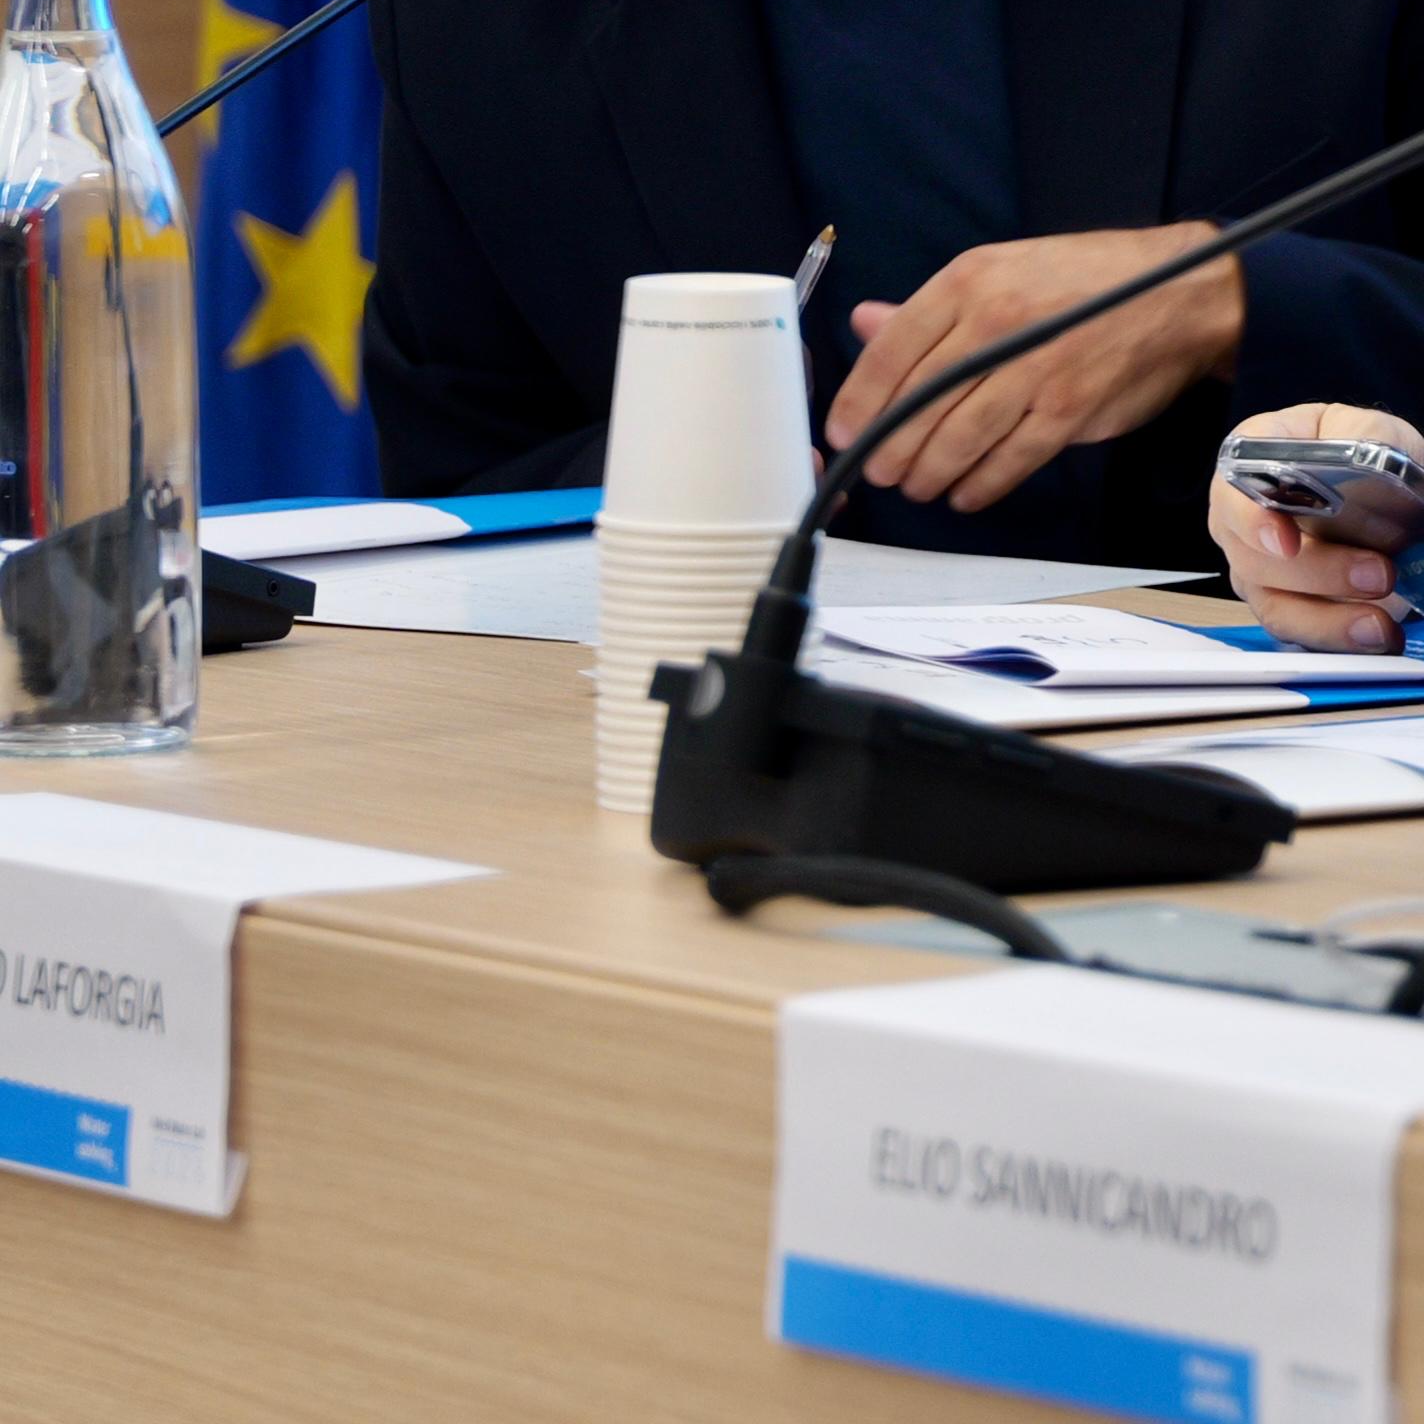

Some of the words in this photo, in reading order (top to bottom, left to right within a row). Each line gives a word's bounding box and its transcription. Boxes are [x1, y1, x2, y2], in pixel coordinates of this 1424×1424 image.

[13, 954, 167, 1035] LAFORGIA
[871, 1126, 962, 1201] ELIO
[967, 1144, 1282, 1264] SANNICANDRO
